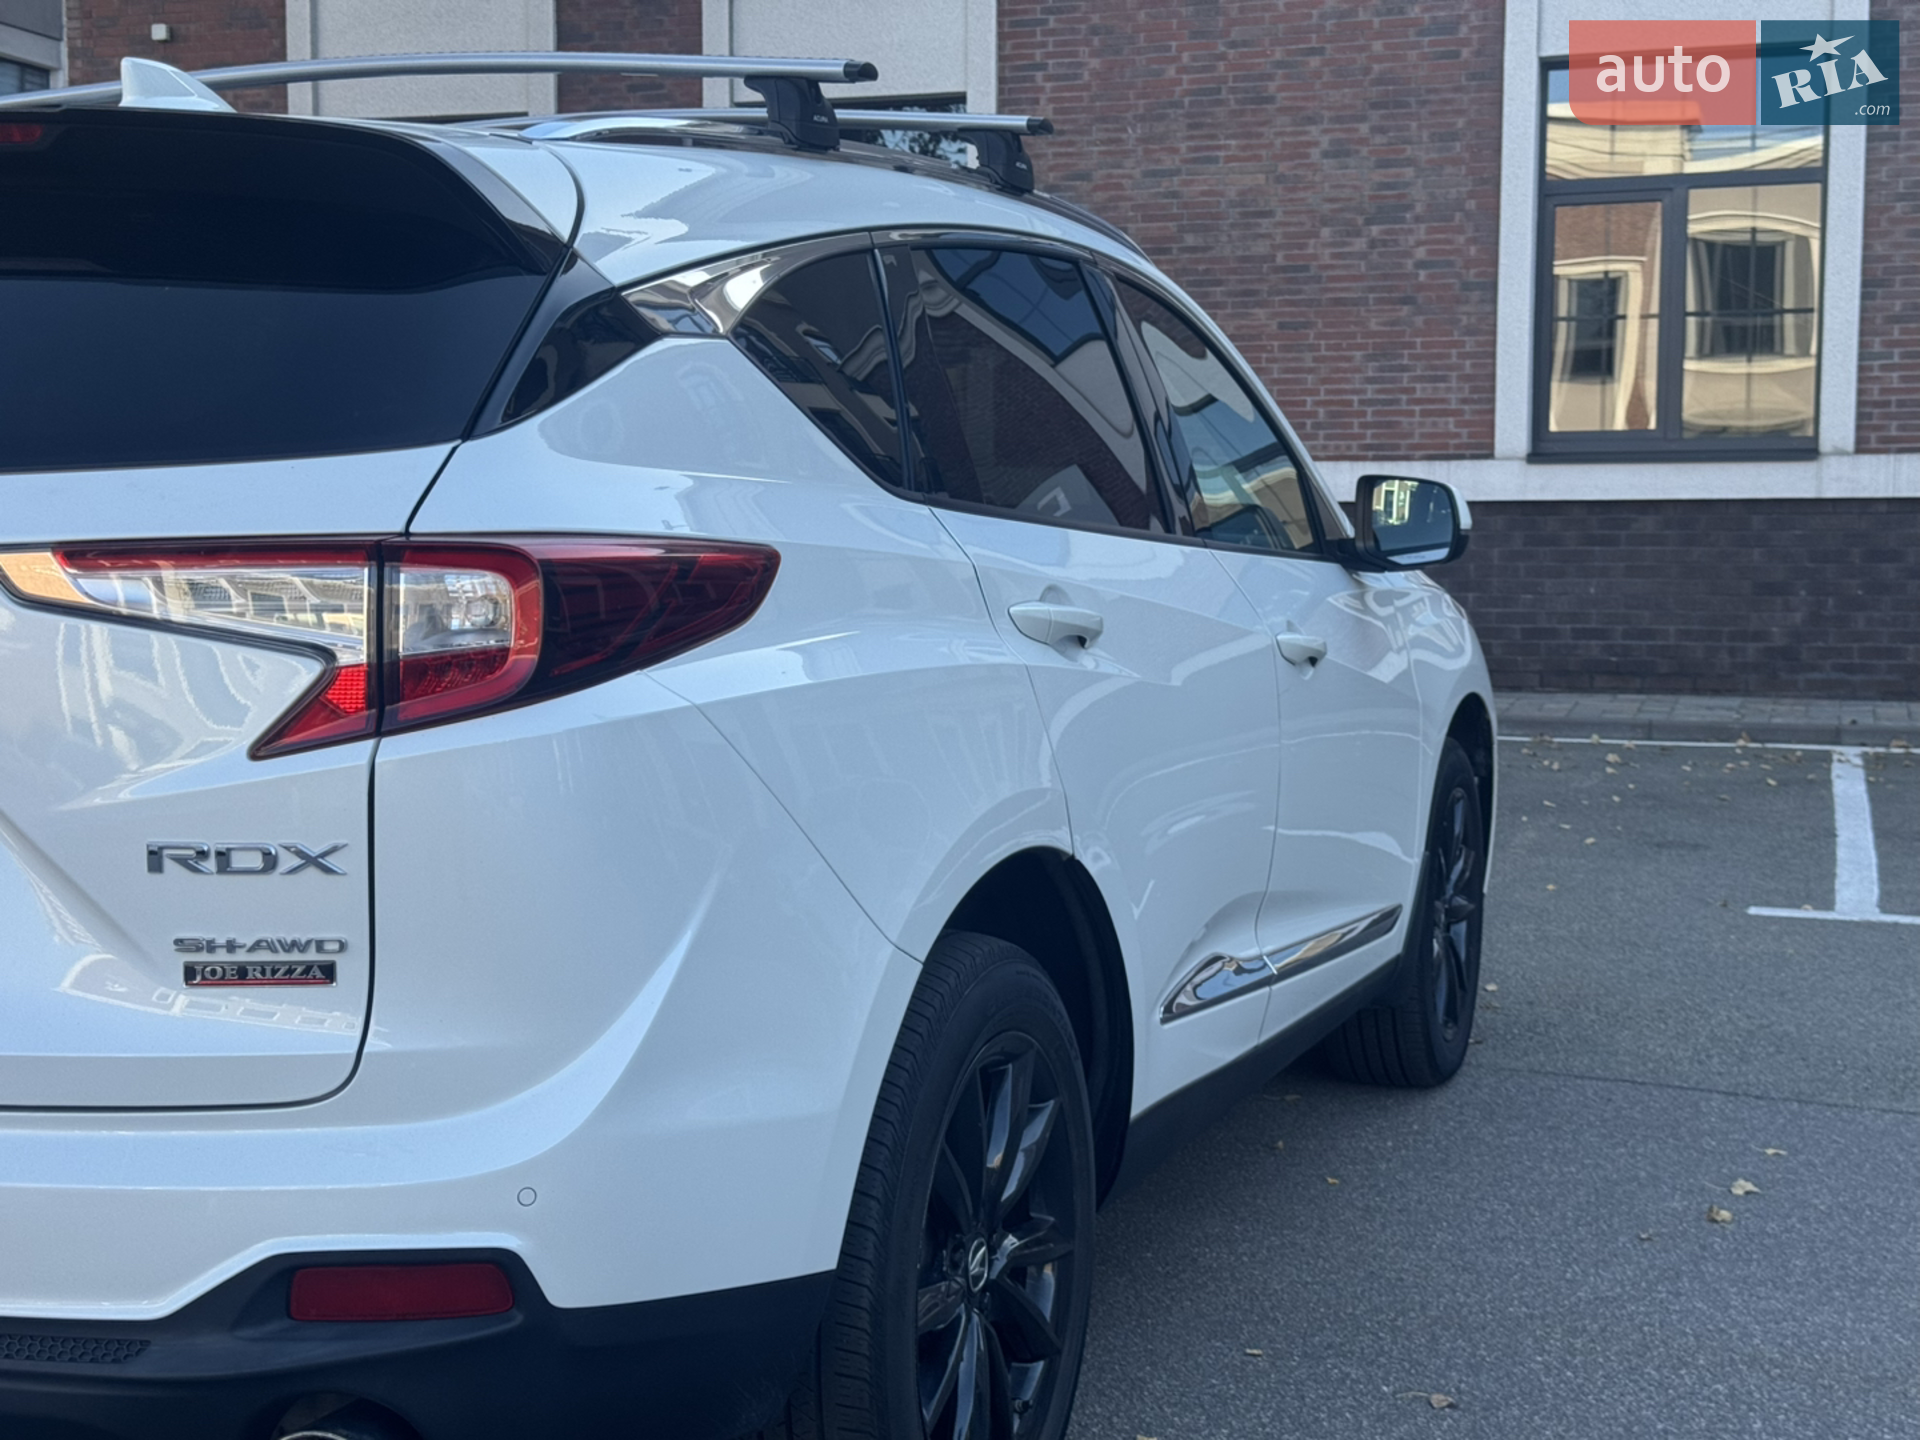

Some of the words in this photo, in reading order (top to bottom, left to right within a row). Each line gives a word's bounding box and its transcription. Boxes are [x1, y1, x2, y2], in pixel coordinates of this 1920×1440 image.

[146, 841, 349, 876] RDX
[192, 965, 239, 984] JOE
[245, 964, 326, 980] RIZZA
